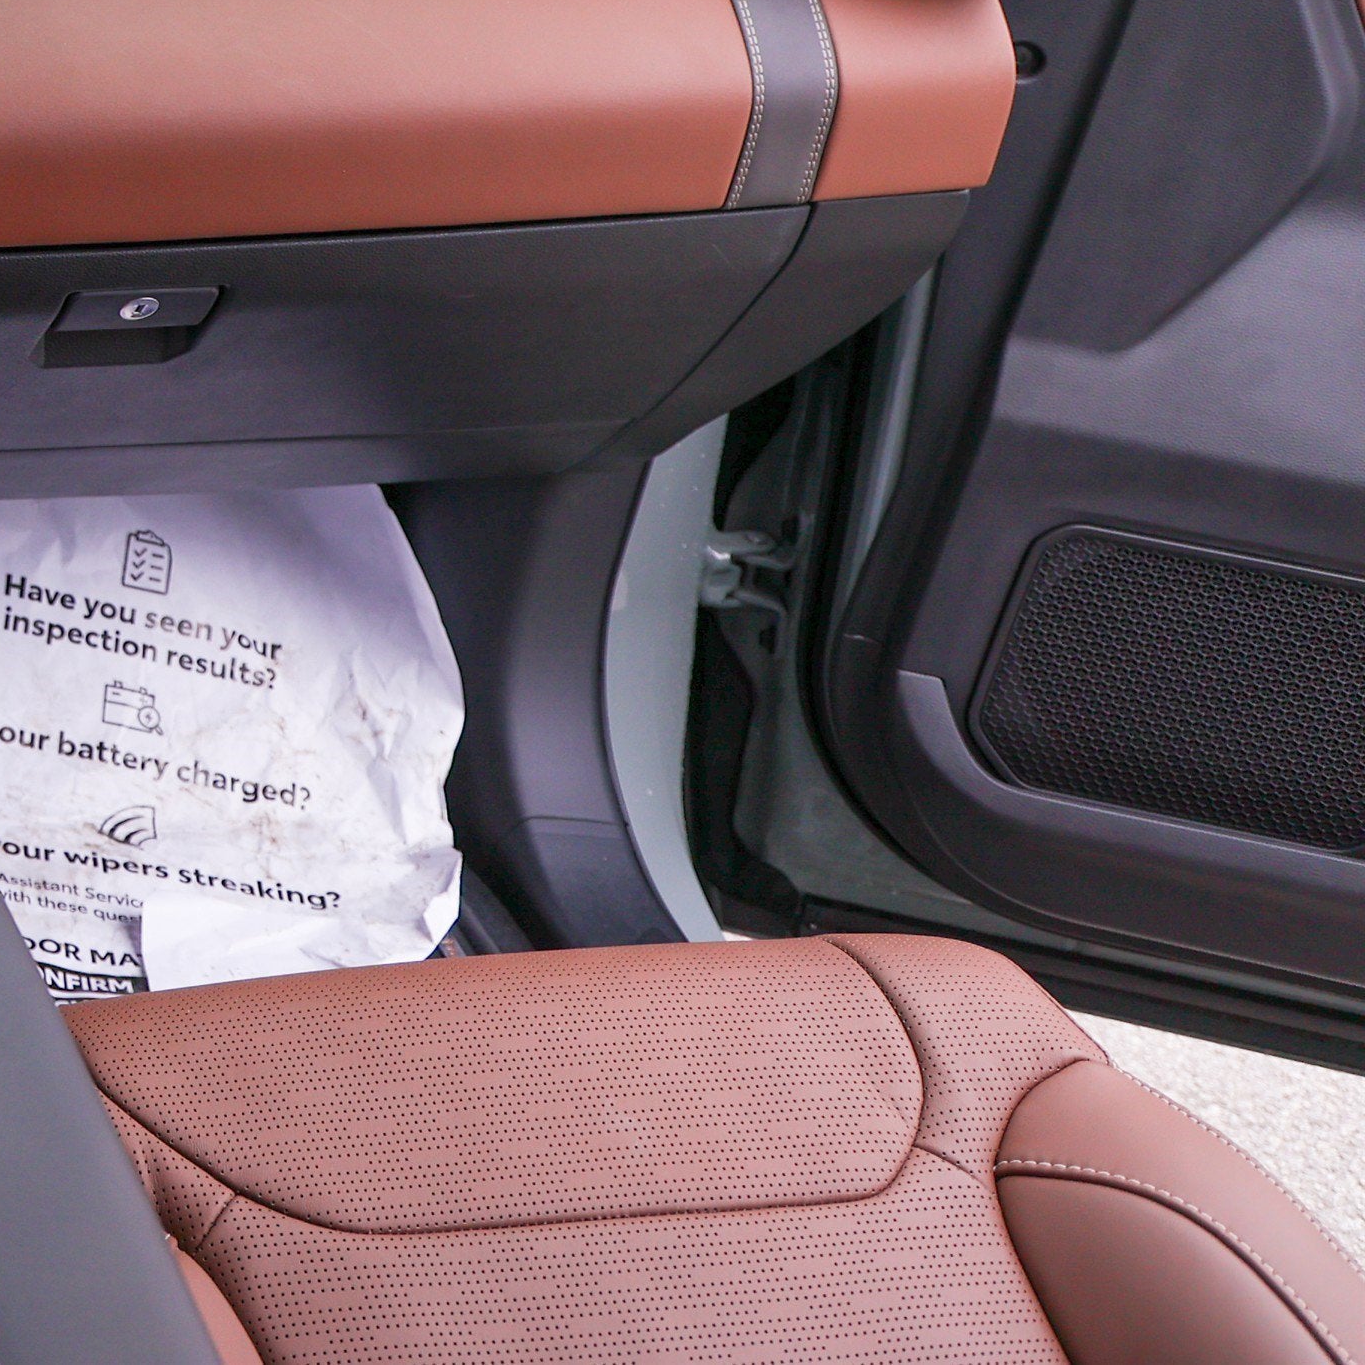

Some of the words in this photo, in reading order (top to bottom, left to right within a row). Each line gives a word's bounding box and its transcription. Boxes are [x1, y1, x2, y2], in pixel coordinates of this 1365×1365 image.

[3, 606, 158, 663] inspection
[166, 648, 277, 689] results?
[4, 573, 75, 610] Have
[83, 597, 136, 625] you
[144, 610, 212, 641] seen
[220, 627, 283, 661] your
[58, 730, 168, 781] battery
[177, 761, 311, 811] charged?
[37, 895, 88, 914] these
[64, 851, 169, 879] wipers
[178, 866, 342, 910] streaking?
